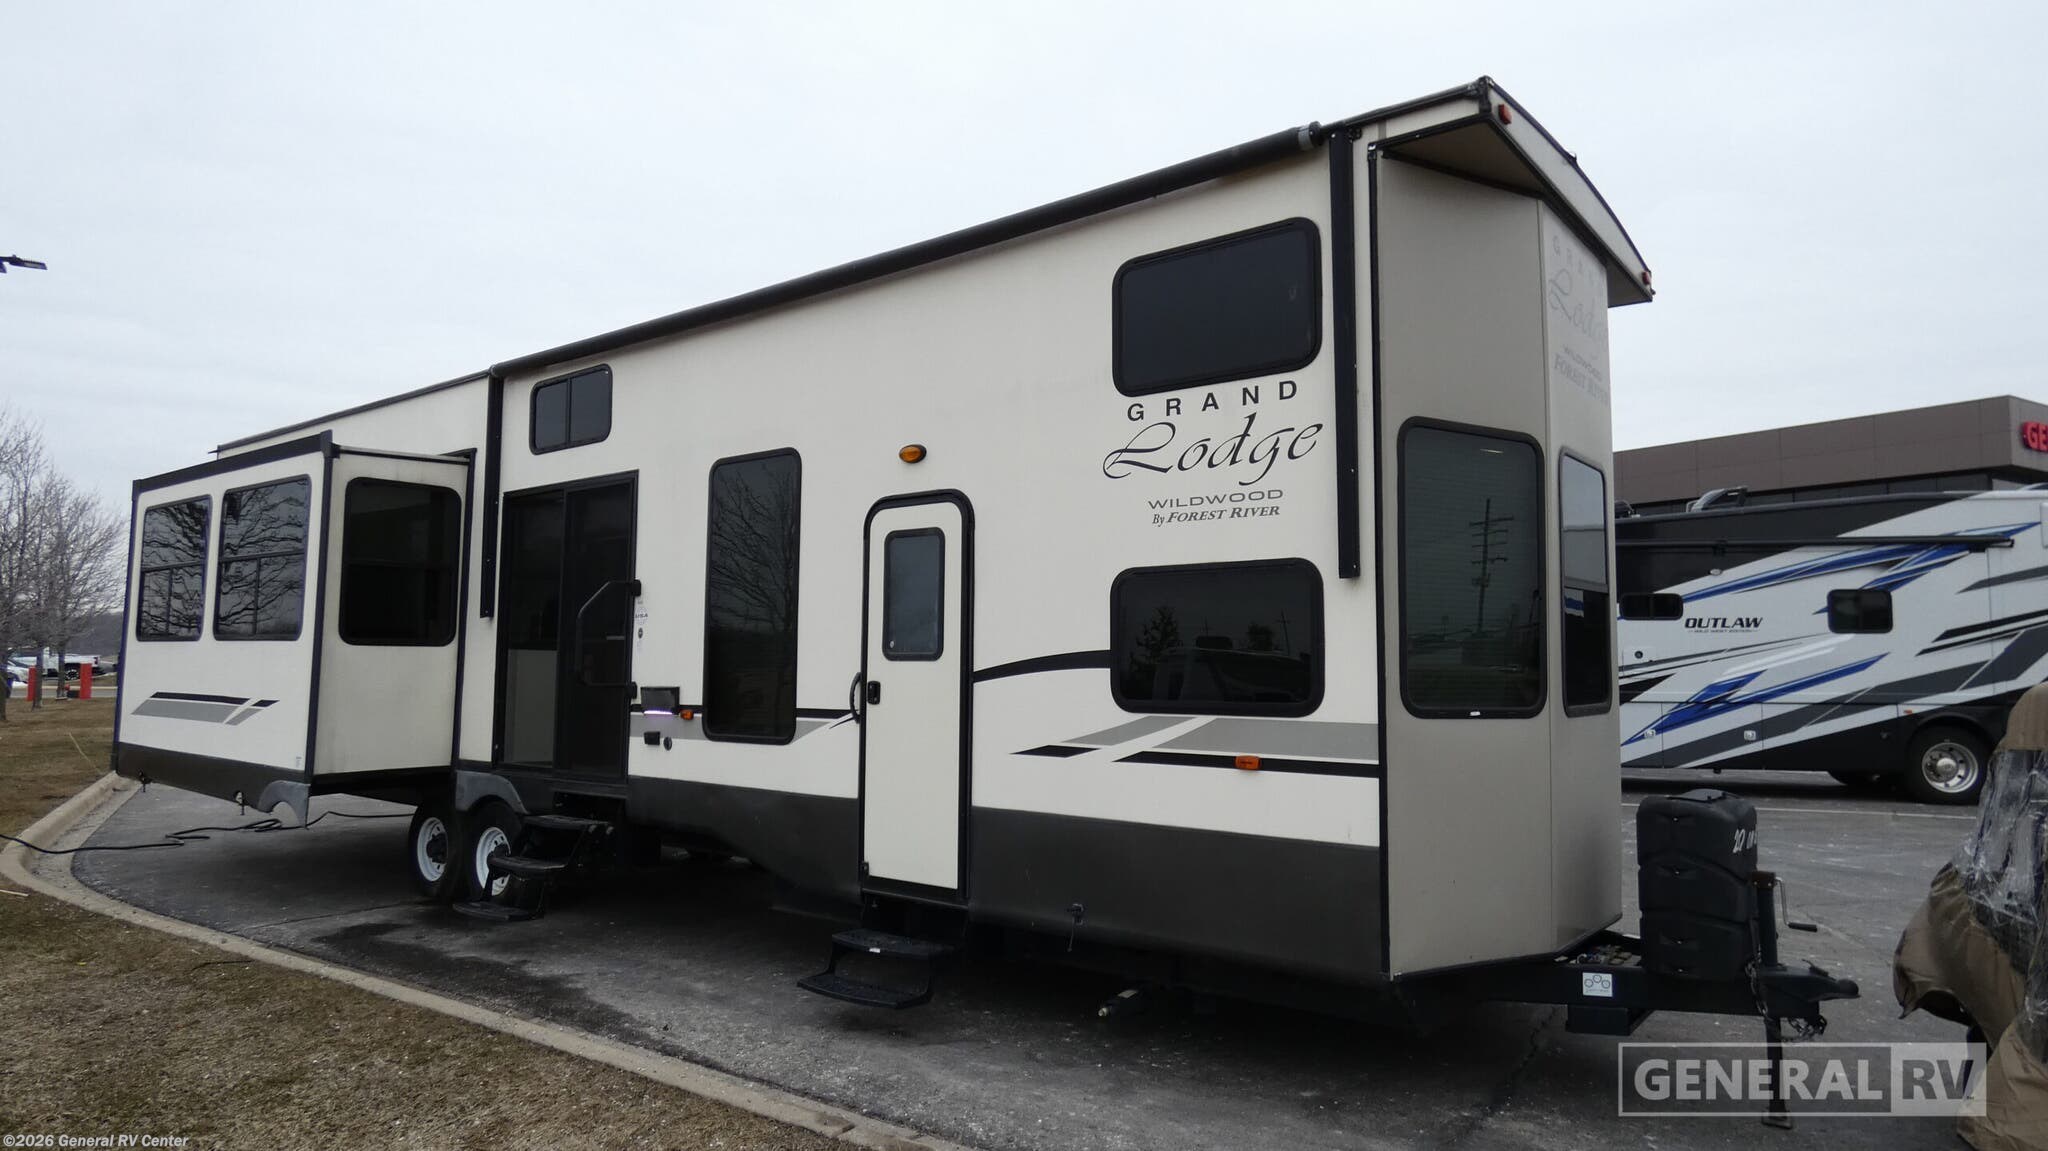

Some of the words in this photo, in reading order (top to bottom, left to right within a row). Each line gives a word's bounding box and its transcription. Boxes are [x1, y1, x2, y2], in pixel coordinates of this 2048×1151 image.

[1127, 380, 1297, 421] GRAND
[1103, 411, 1323, 486] Lodge
[1148, 489, 1283, 509] WILDWOOD
[1152, 513, 1165, 527] By
[1167, 509, 1227, 523] FOREST
[1229, 505, 1280, 519] RIVER
[1684, 617, 1763, 628] OUTLAW
